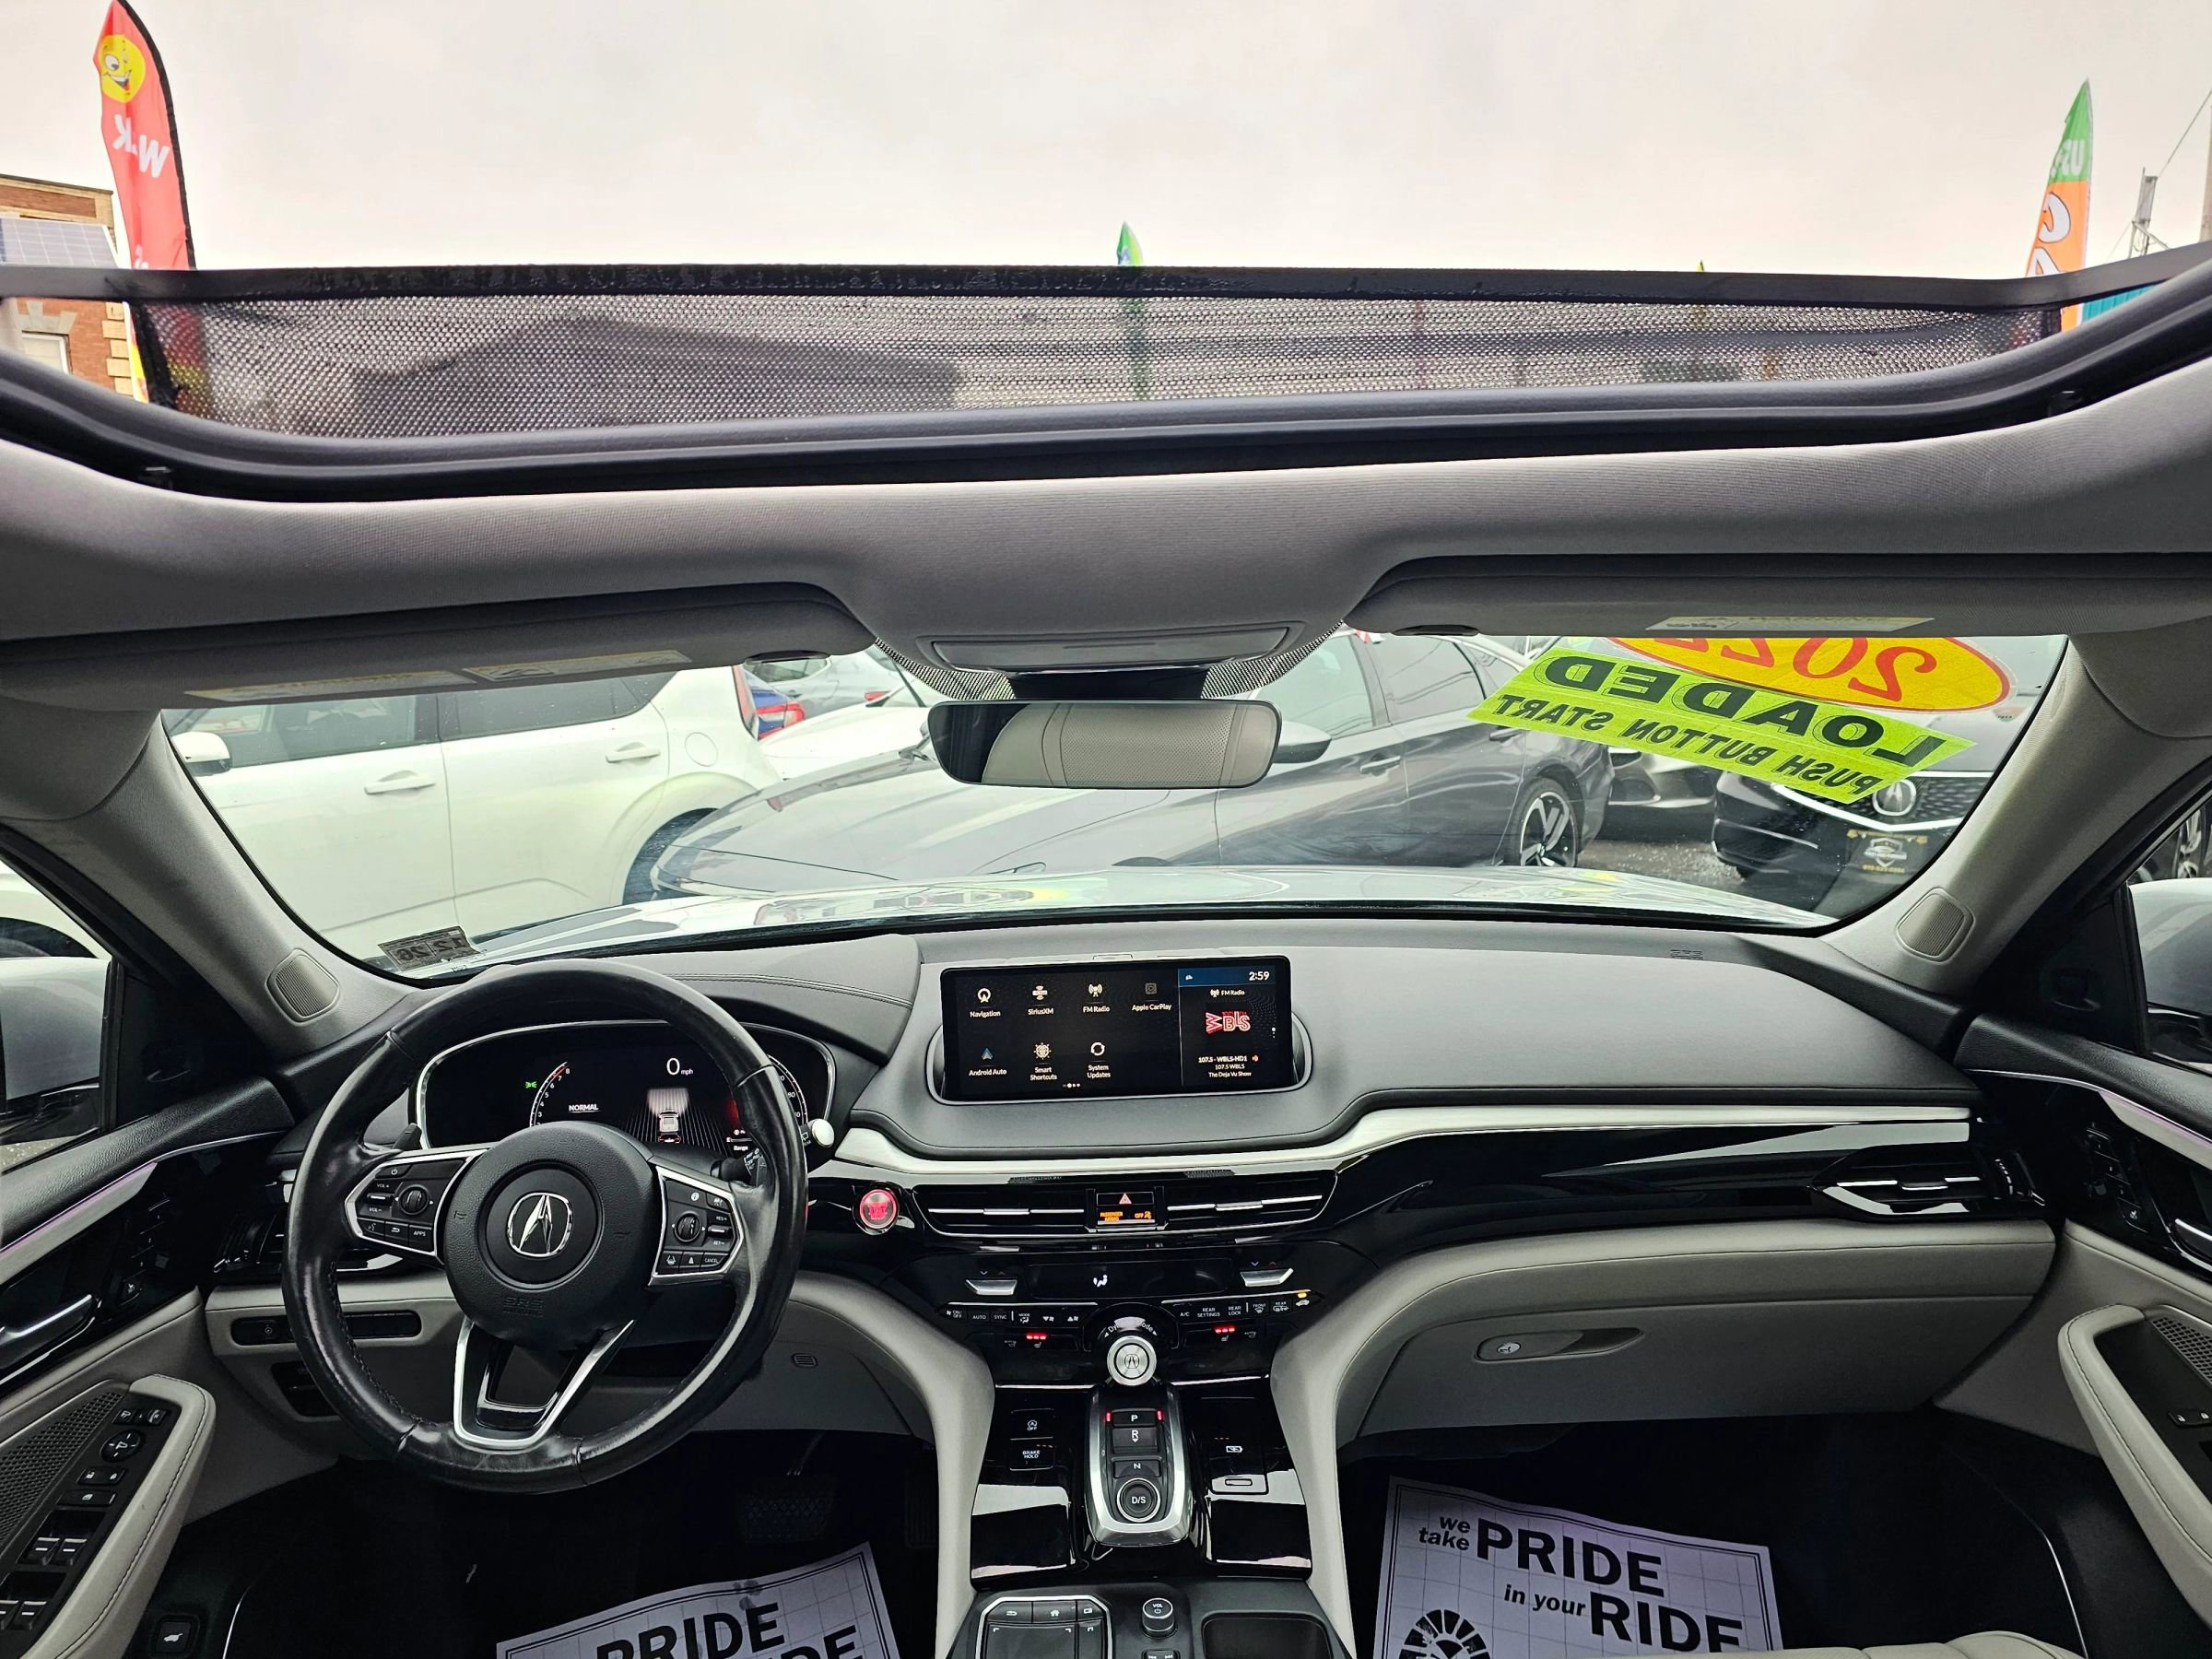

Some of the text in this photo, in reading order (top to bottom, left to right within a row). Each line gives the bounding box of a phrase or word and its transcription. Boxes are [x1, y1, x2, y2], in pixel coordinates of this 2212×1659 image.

[1249, 971, 1270, 982] 2:59
[1149, 1003, 1172, 1011] CarPlay
[970, 1010, 1001, 1018] Navigation
[666, 1057, 681, 1076] 0
[1088, 1064, 1110, 1072] System
[569, 1103, 599, 1112] NORMAL
[1131, 1430, 1139, 1439] R
[1131, 1496, 1147, 1504] D/S
[1440, 1516, 1471, 1534] we
[1418, 1517, 1665, 1598] take PRIDE
[1503, 1583, 1526, 1605] in
[1533, 1594, 1586, 1617] your
